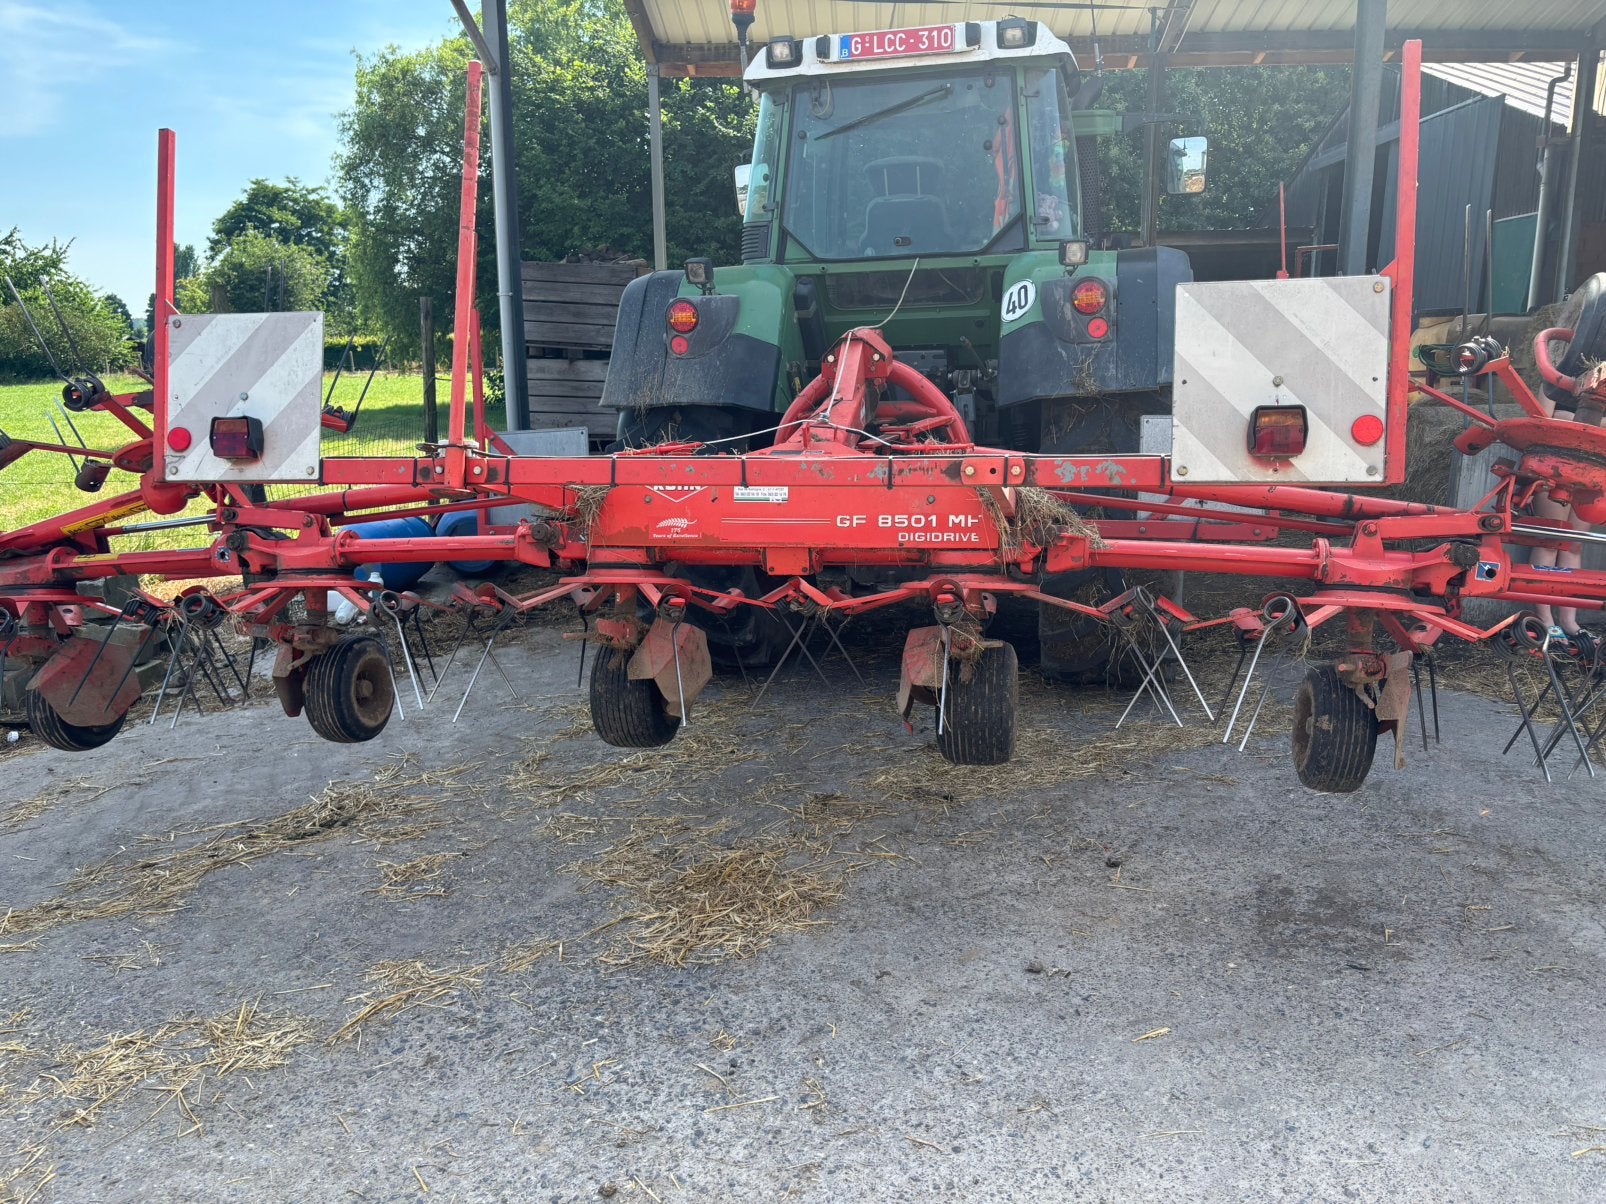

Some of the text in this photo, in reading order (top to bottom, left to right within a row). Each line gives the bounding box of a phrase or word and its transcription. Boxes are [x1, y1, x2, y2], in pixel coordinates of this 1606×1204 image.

[841, 48, 849, 57] B
[1005, 284, 1029, 315] 40
[836, 514, 867, 527] GF
[878, 514, 937, 527] 8501
[898, 532, 980, 542] DIGIDRIVE
